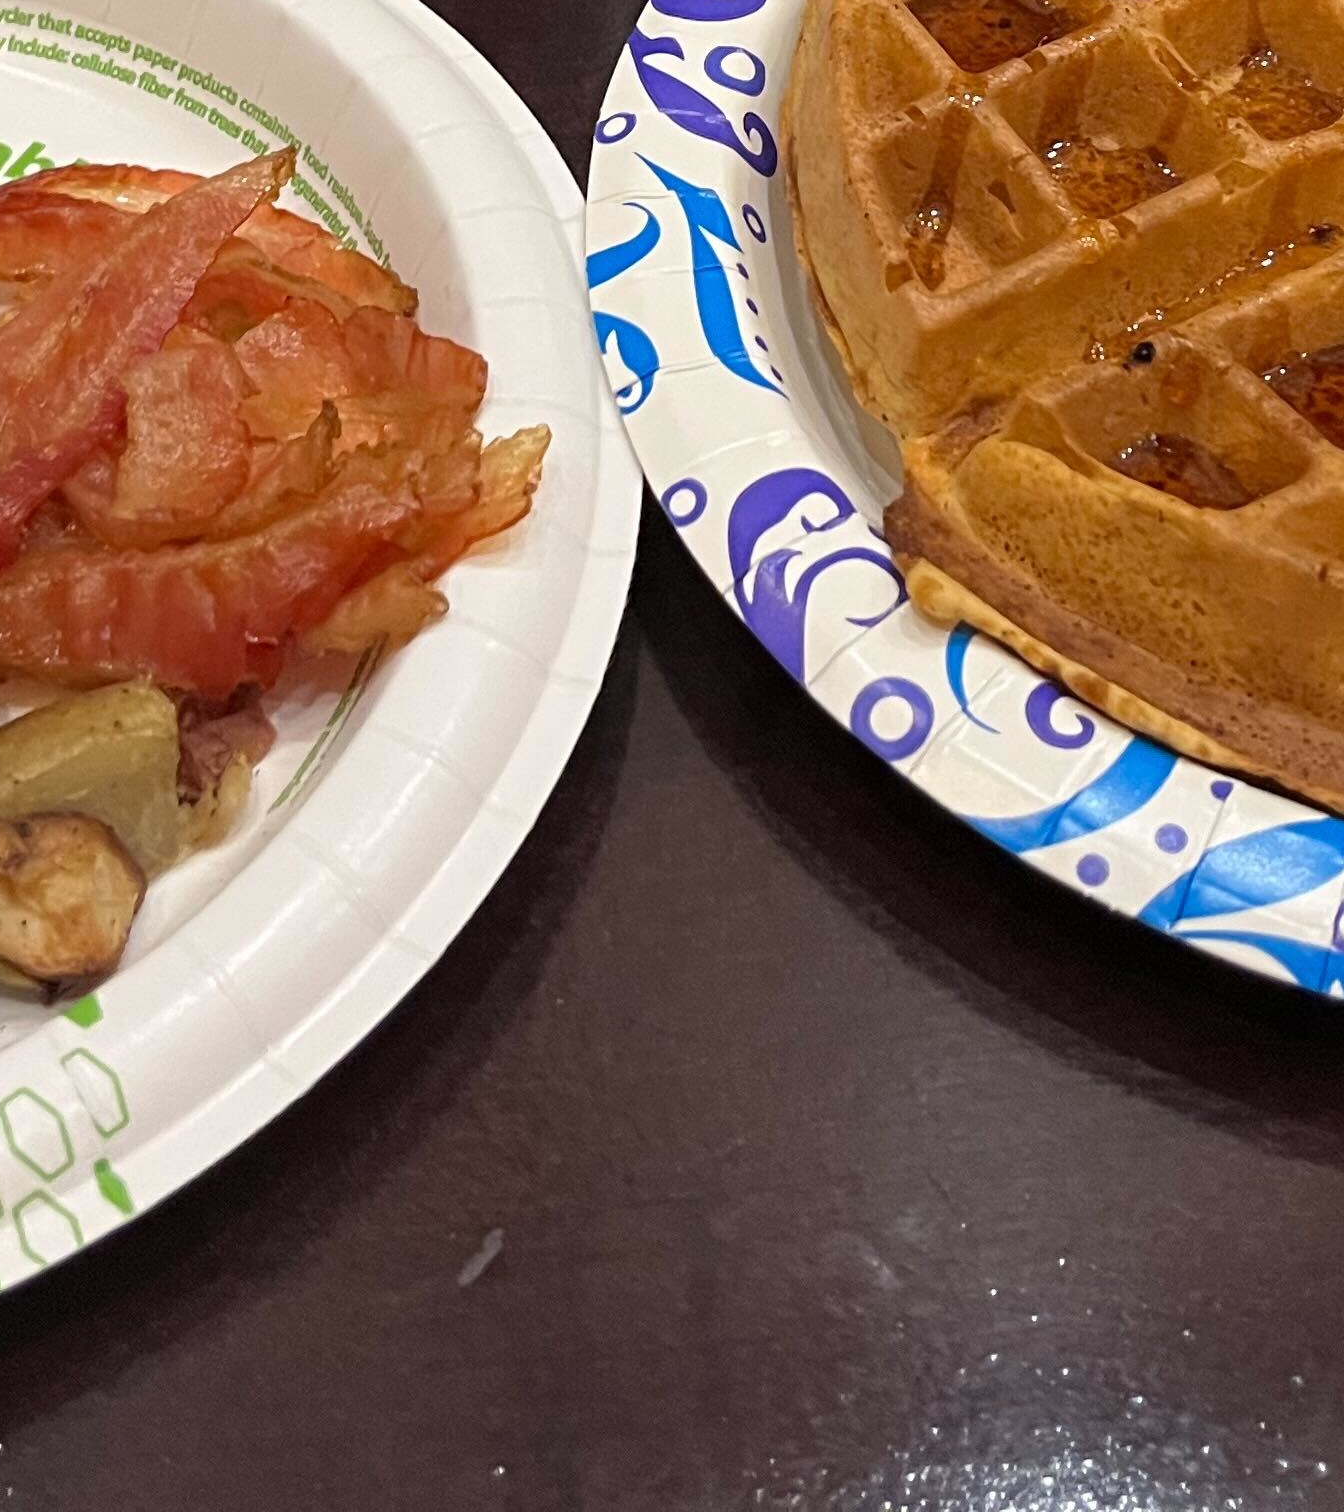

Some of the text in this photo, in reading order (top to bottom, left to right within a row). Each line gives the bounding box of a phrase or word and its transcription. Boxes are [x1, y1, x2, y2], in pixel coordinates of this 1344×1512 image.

[38, 11, 73, 36] that
[74, 24, 131, 54] accepts
[132, 43, 179, 72] paper
[177, 63, 238, 106] products
[71, 53, 137, 85] cellulose
[174, 87, 208, 118] from
